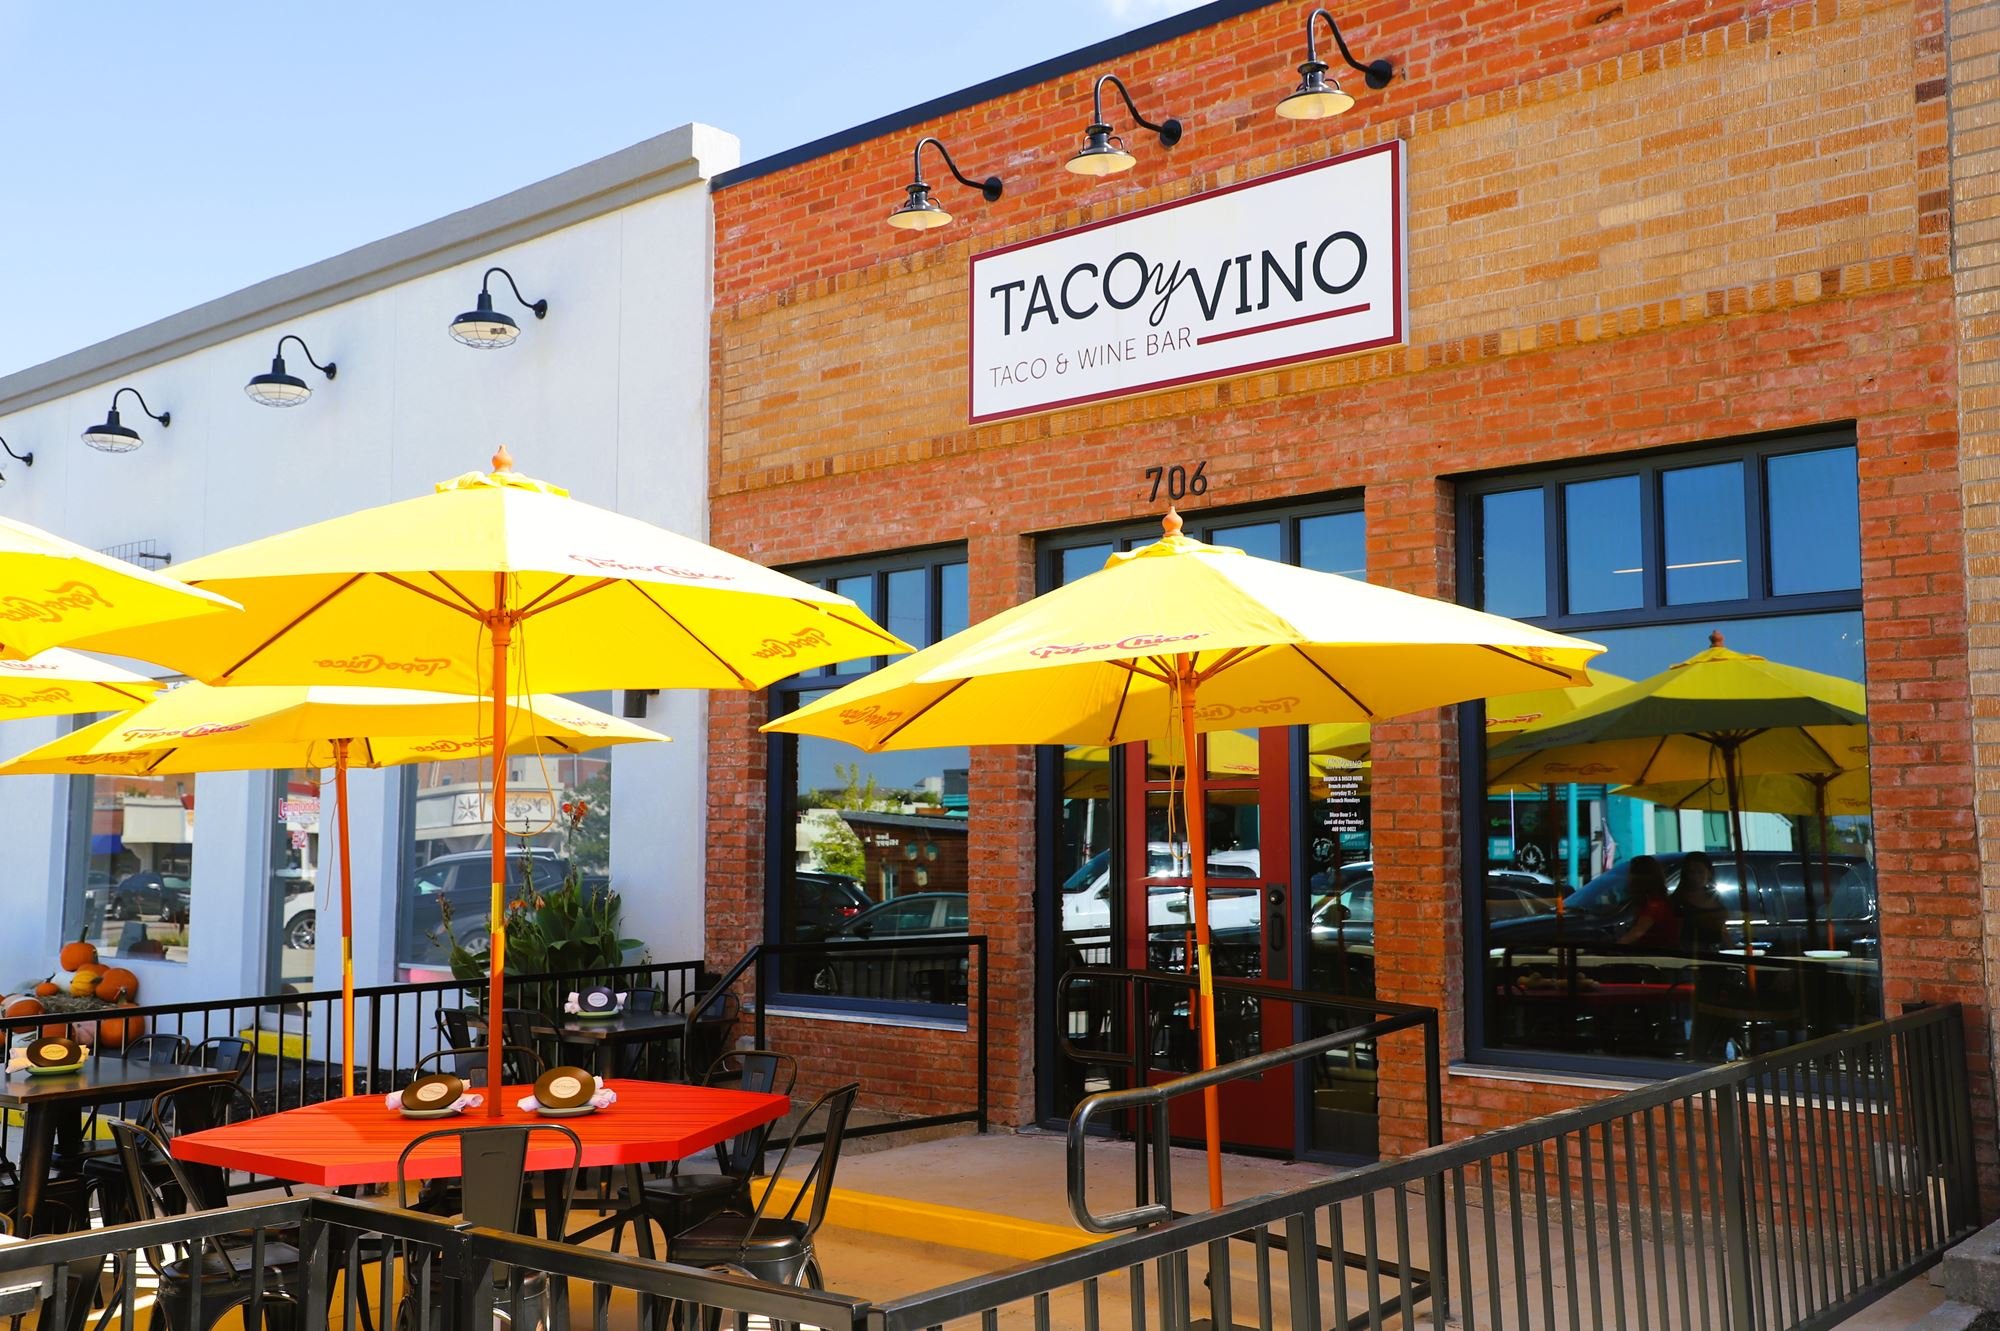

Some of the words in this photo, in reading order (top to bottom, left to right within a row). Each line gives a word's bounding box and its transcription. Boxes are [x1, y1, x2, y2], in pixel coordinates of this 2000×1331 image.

[990, 251, 1149, 336] TACO
[1187, 231, 1367, 321] VINO
[989, 357, 1047, 388] TACO
[1055, 353, 1069, 375] &
[1077, 338, 1136, 370] WINE
[1146, 327, 1191, 356] BAR
[1145, 460, 1207, 503] 706
[1030, 641, 1110, 659] Topo
